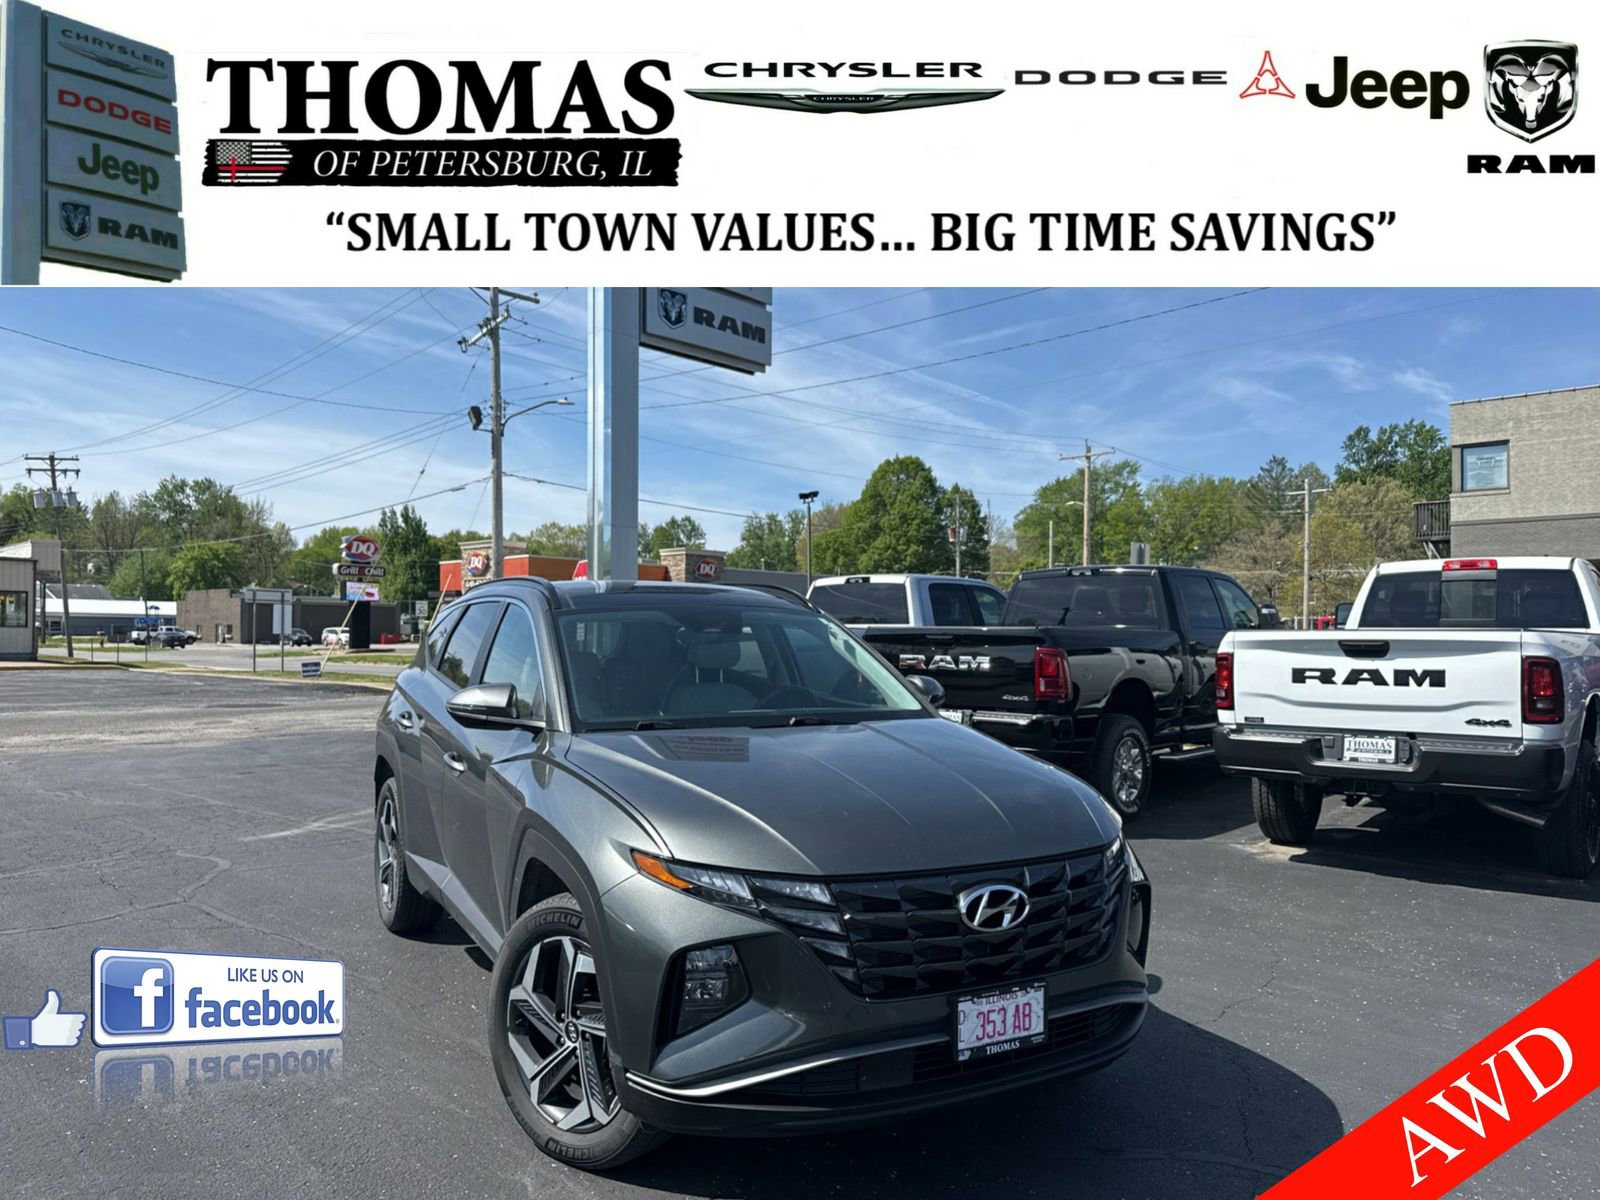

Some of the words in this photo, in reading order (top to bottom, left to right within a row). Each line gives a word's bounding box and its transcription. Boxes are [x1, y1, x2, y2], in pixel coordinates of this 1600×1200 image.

[693, 306, 766, 344] RAM
[351, 540, 376, 557] DQ
[340, 566, 359, 575] Grill
[364, 567, 385, 577] Chill
[700, 562, 716, 576] DQ
[899, 653, 992, 672] RAM
[1291, 667, 1447, 688] RAM
[1464, 718, 1512, 728] 4x4
[1346, 739, 1393, 750] THOMAS
[976, 1006, 1008, 1041] 353
[1013, 1001, 1032, 1034] AB
[986, 1040, 1020, 1055] THOMAS
